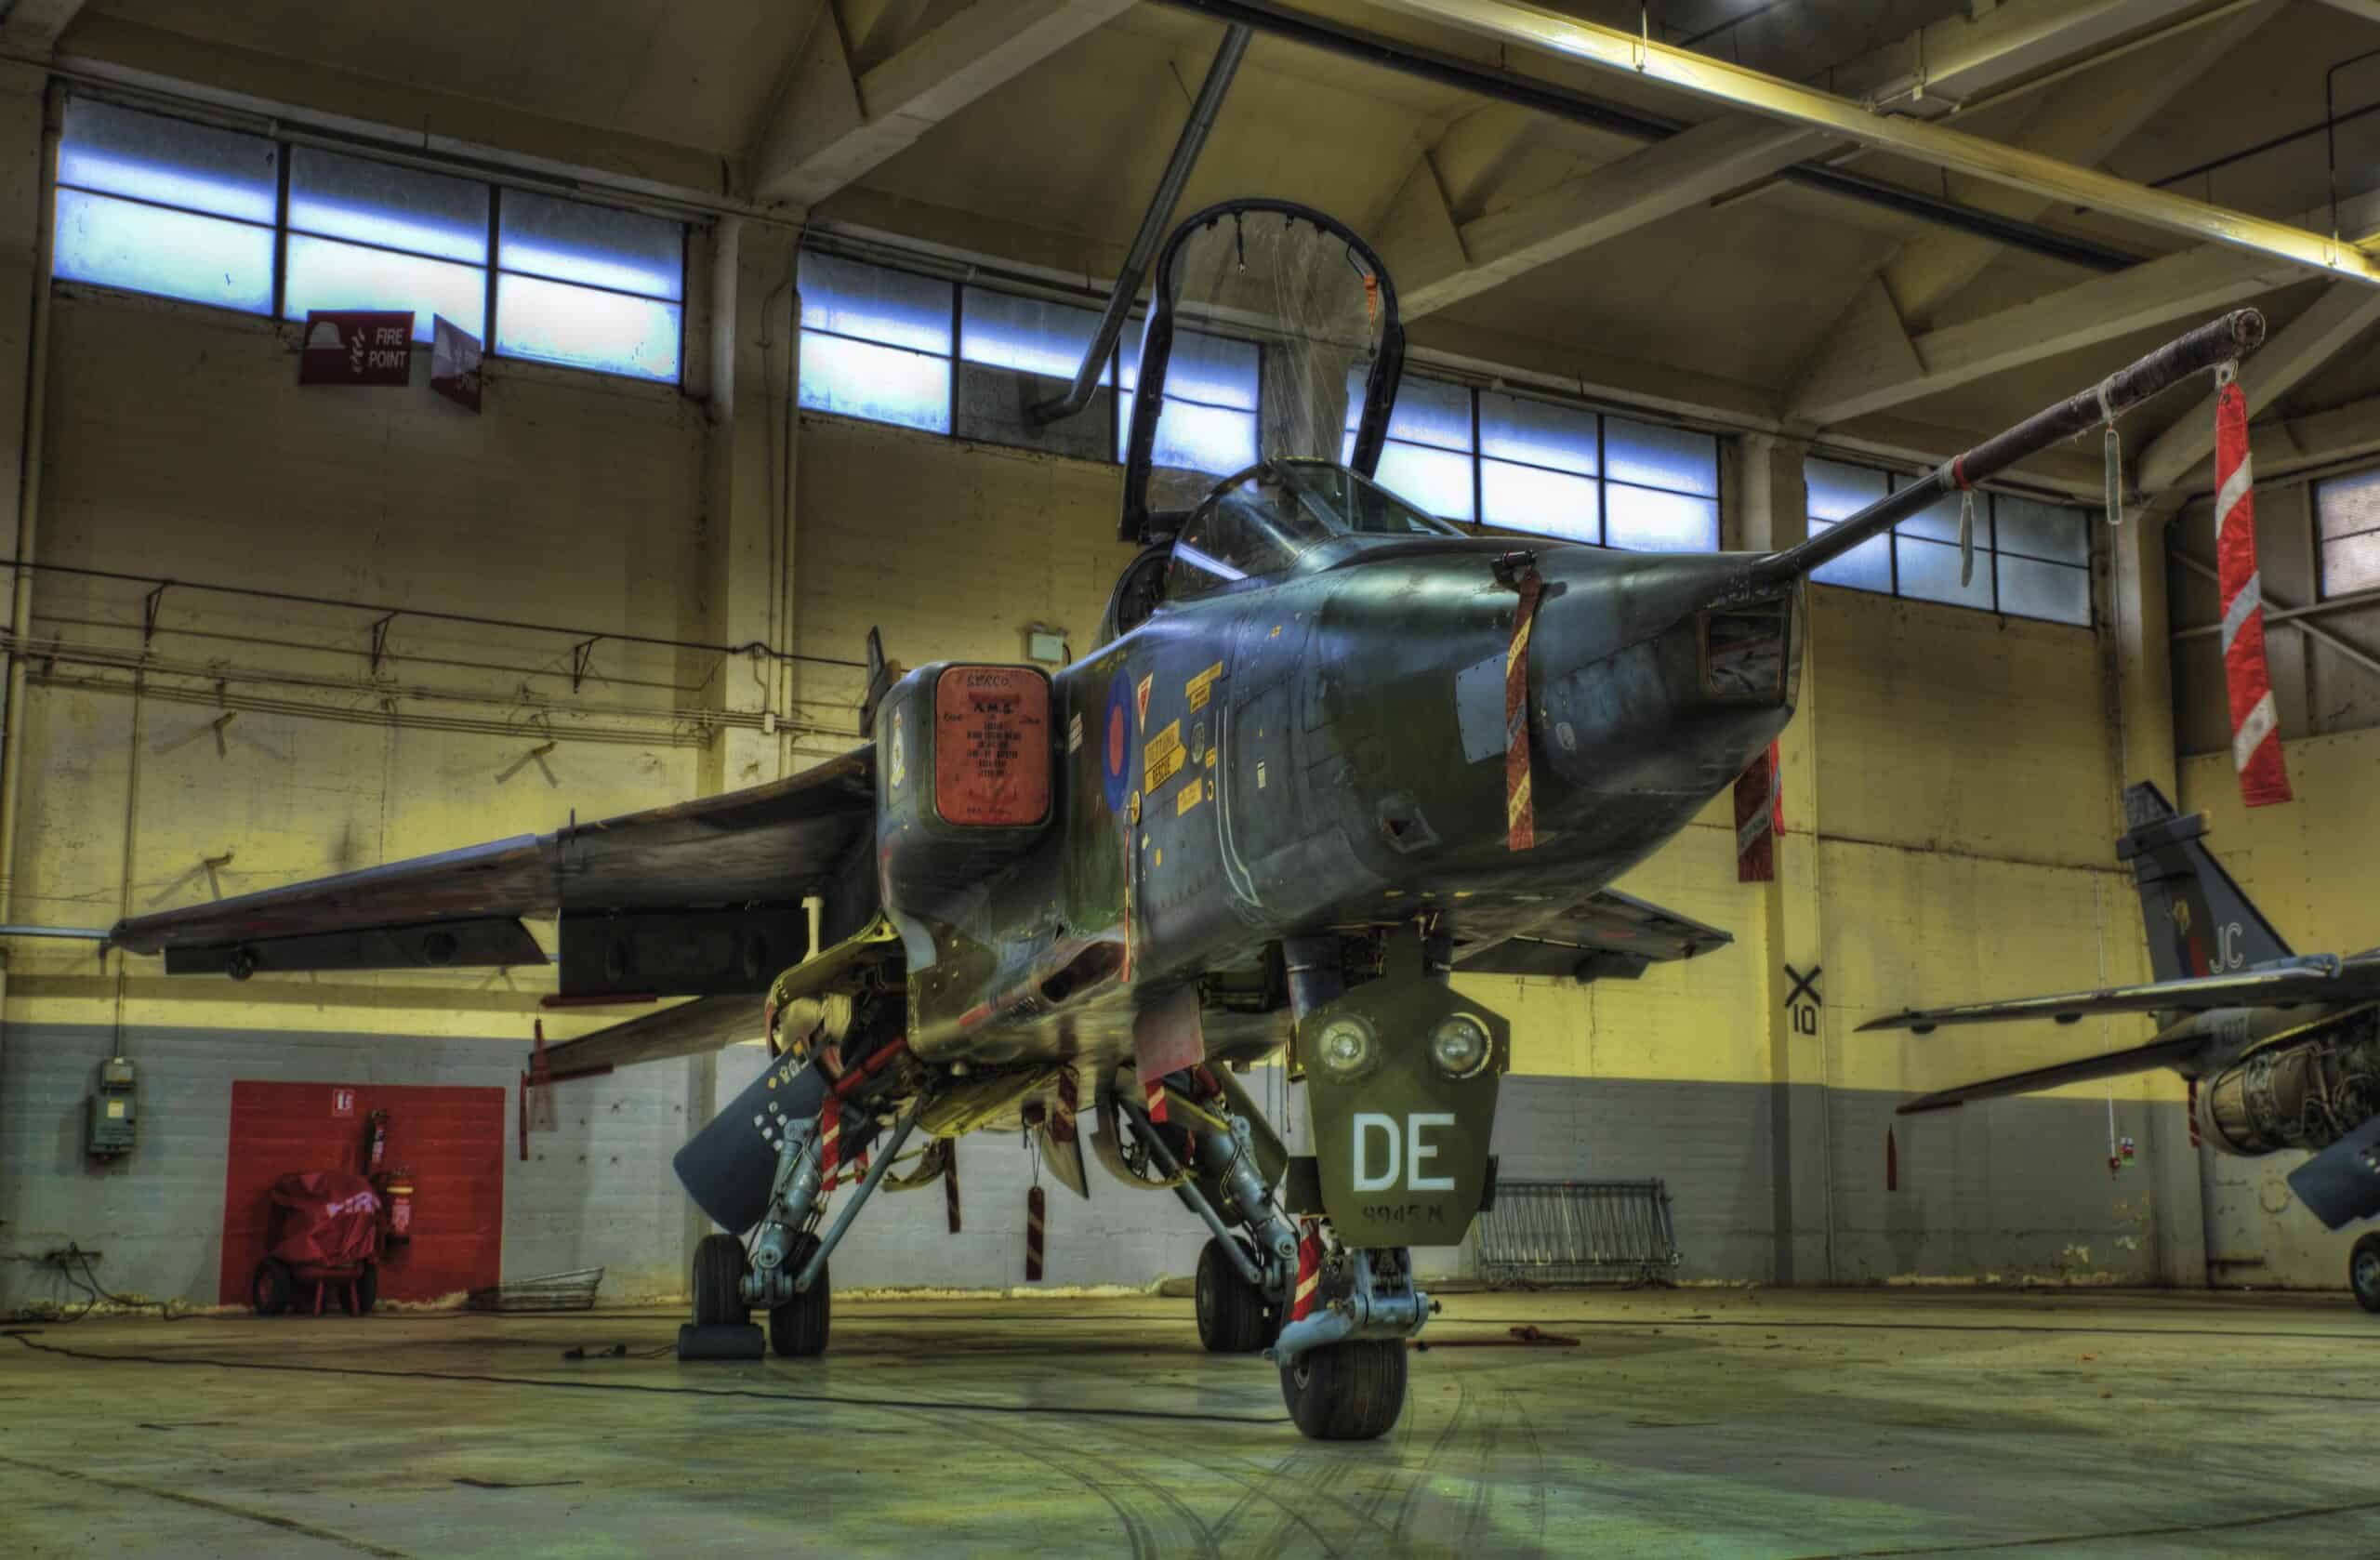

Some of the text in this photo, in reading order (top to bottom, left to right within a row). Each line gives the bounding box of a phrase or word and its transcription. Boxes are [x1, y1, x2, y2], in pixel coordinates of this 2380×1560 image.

[376, 327, 404, 345] FIRE
[369, 350, 406, 368] POINT
[2209, 922, 2243, 973] JC
[1793, 1003, 1816, 1035] 10
[1354, 1113, 1456, 1192] DE
